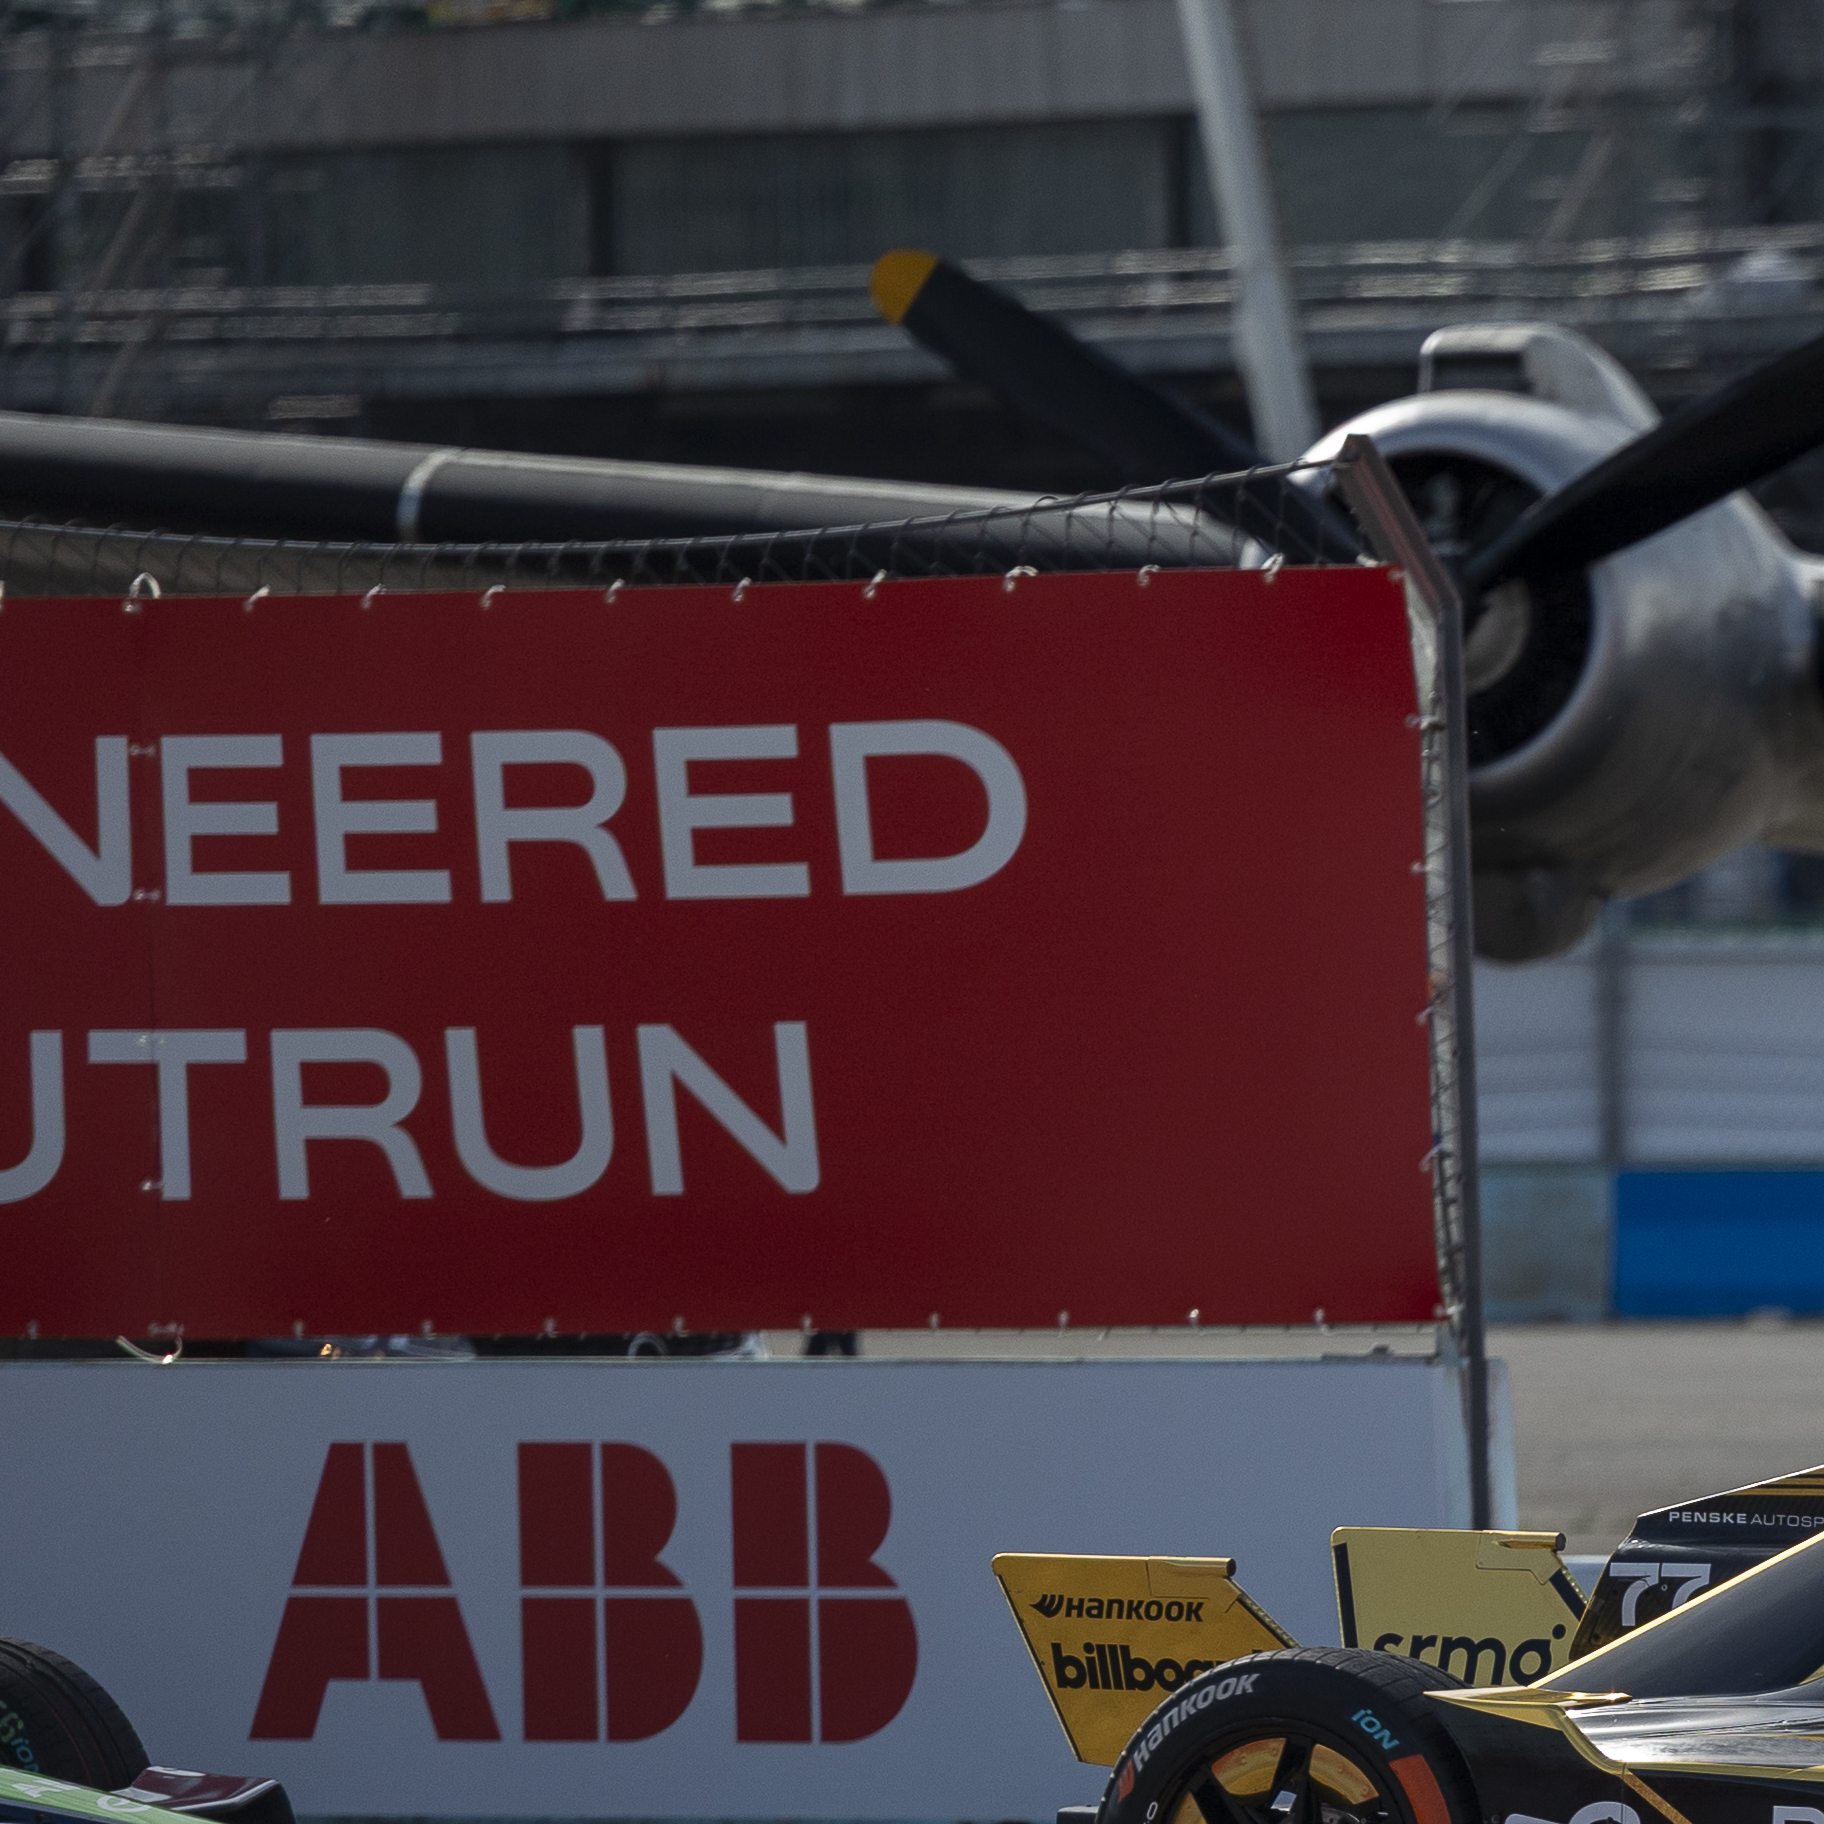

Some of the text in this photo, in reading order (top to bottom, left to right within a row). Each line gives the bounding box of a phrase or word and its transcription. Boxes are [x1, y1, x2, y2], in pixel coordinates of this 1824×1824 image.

[1669, 1511, 1747, 1524] PENSKE
[249, 1441, 918, 1745] ABB
[1609, 1562, 1712, 1627] 77
